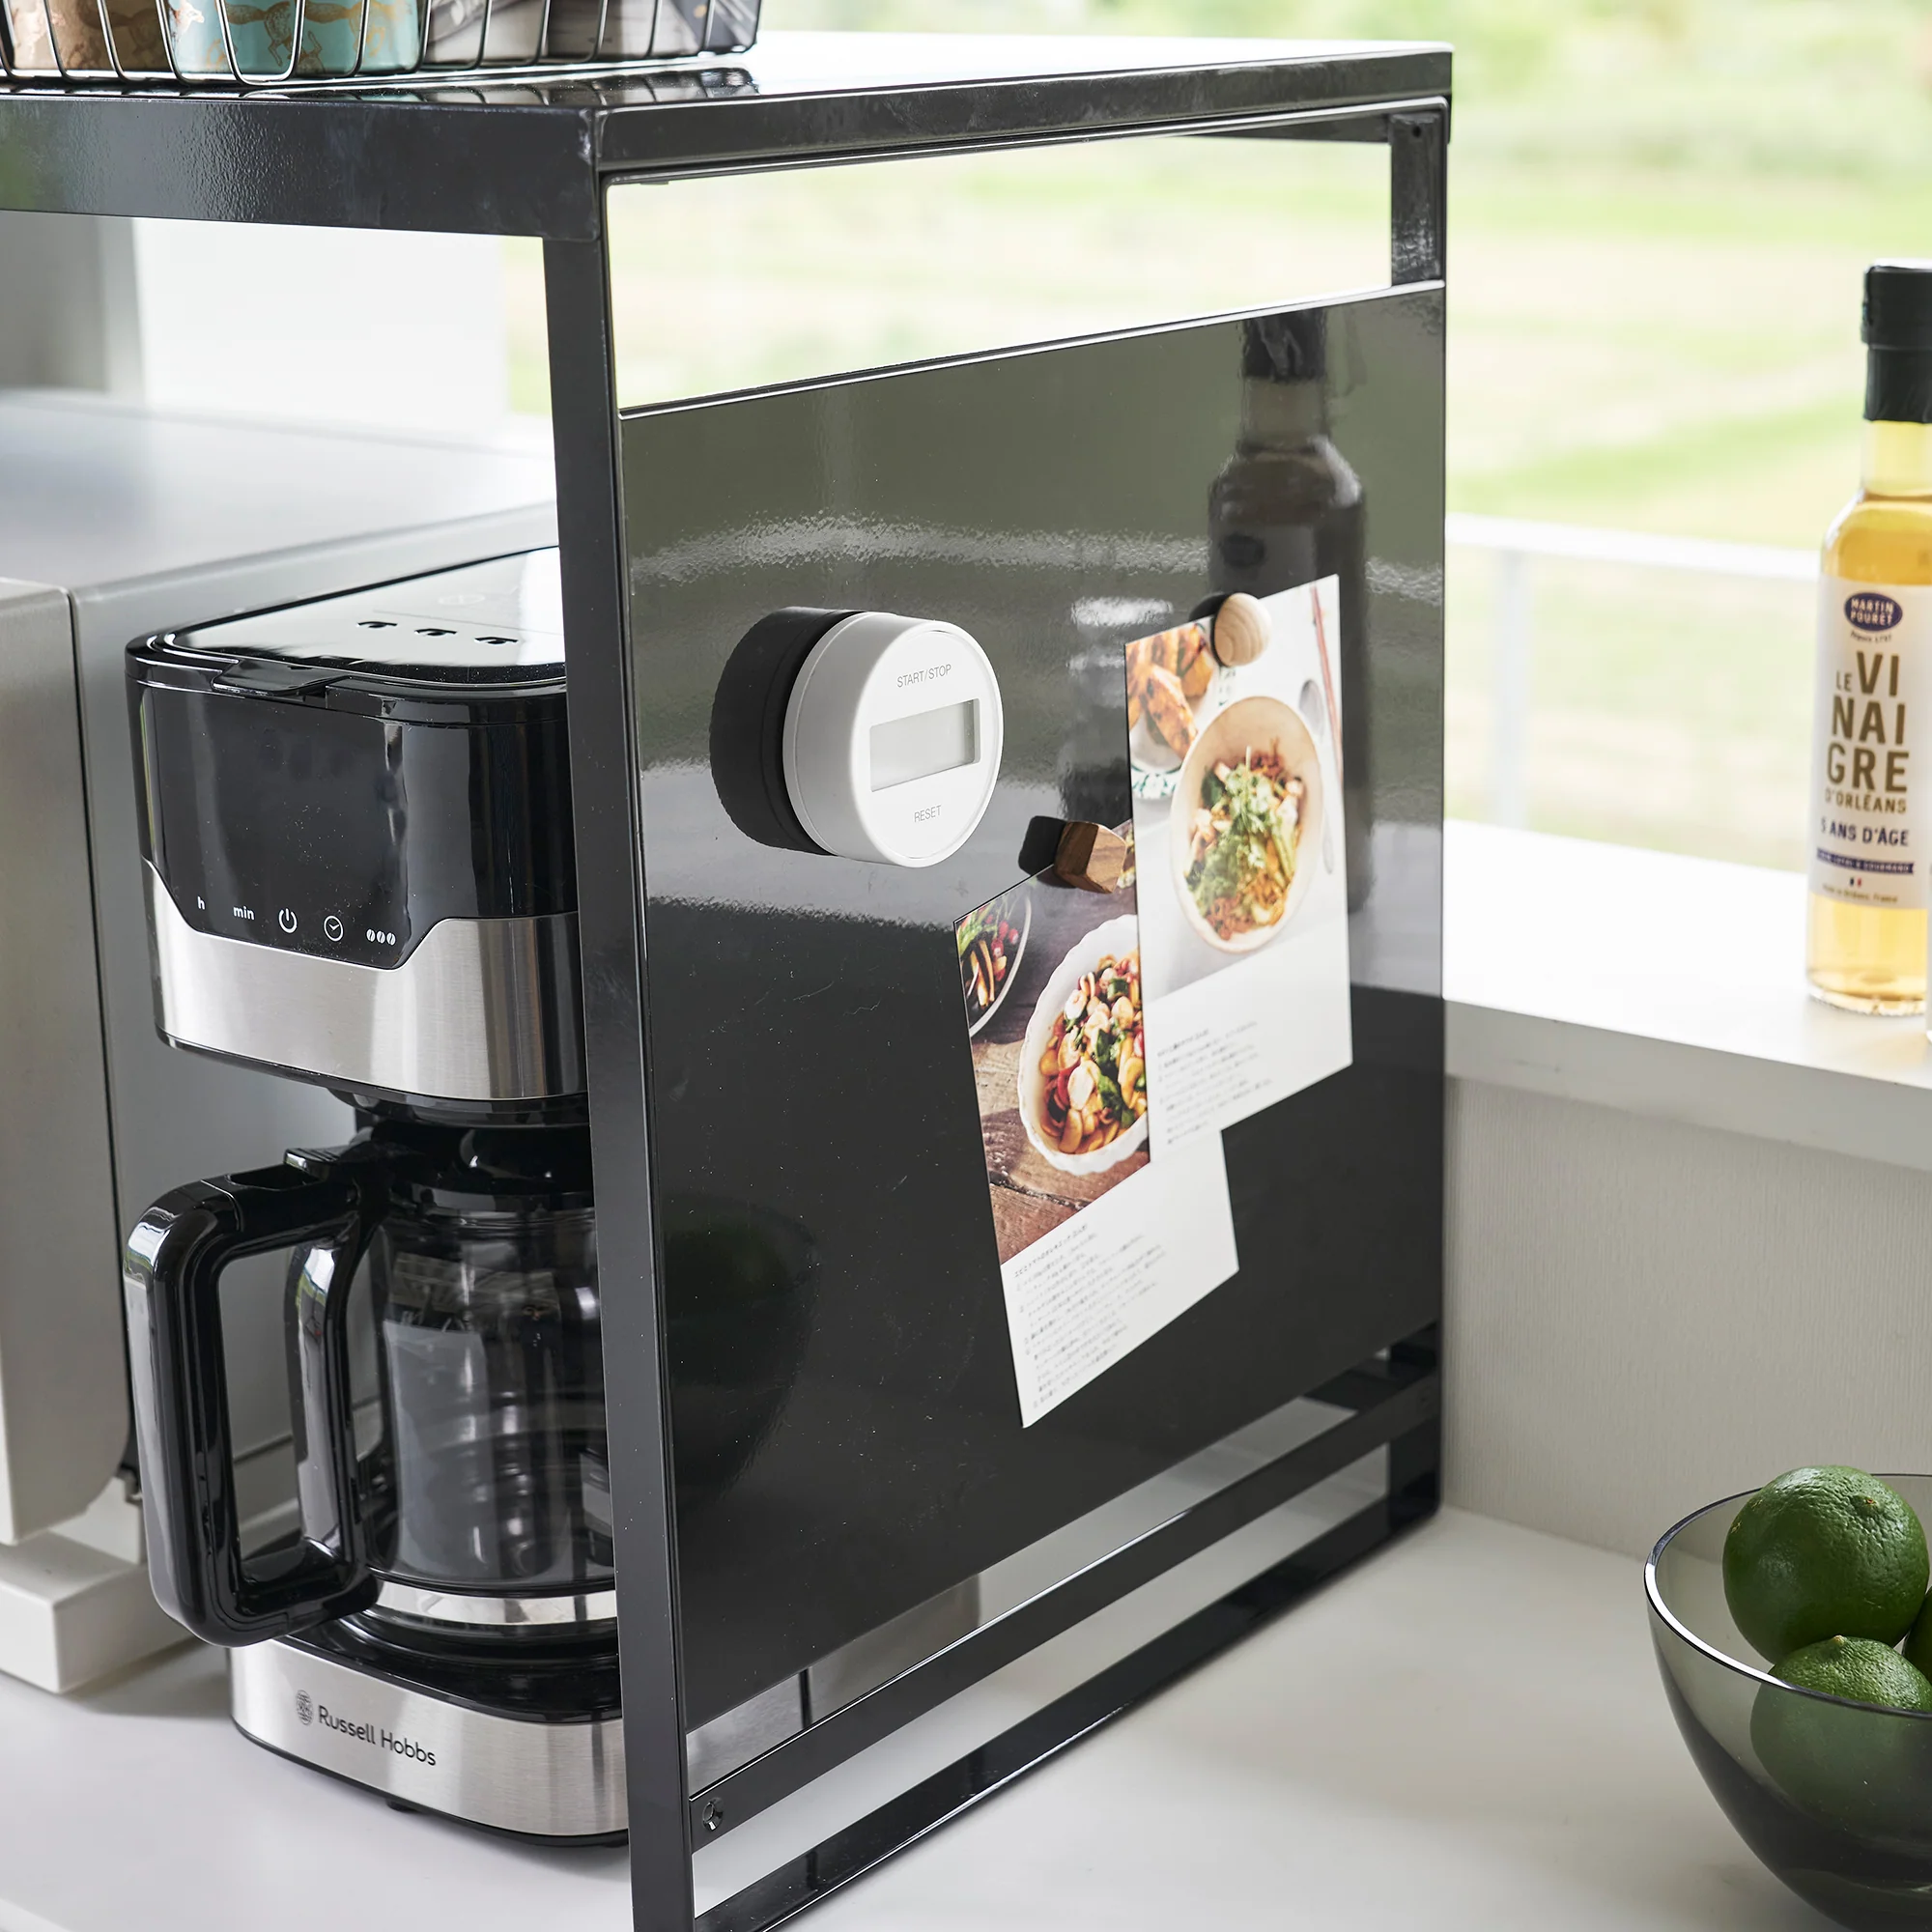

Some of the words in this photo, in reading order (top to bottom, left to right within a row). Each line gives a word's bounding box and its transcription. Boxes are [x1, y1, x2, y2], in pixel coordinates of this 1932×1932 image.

[896, 664, 952, 688] START/STOP
[1836, 670, 1853, 692] LE
[1856, 650, 1899, 697] VI
[1832, 695, 1906, 745] NAI
[1827, 741, 1910, 792] GRE
[914, 805, 942, 823] RESET
[1830, 820, 1857, 841] ANS
[197, 896, 206, 910] h
[233, 904, 255, 921] min
[318, 1705, 376, 1746] Russell
[381, 1728, 437, 1766] Hobbs
